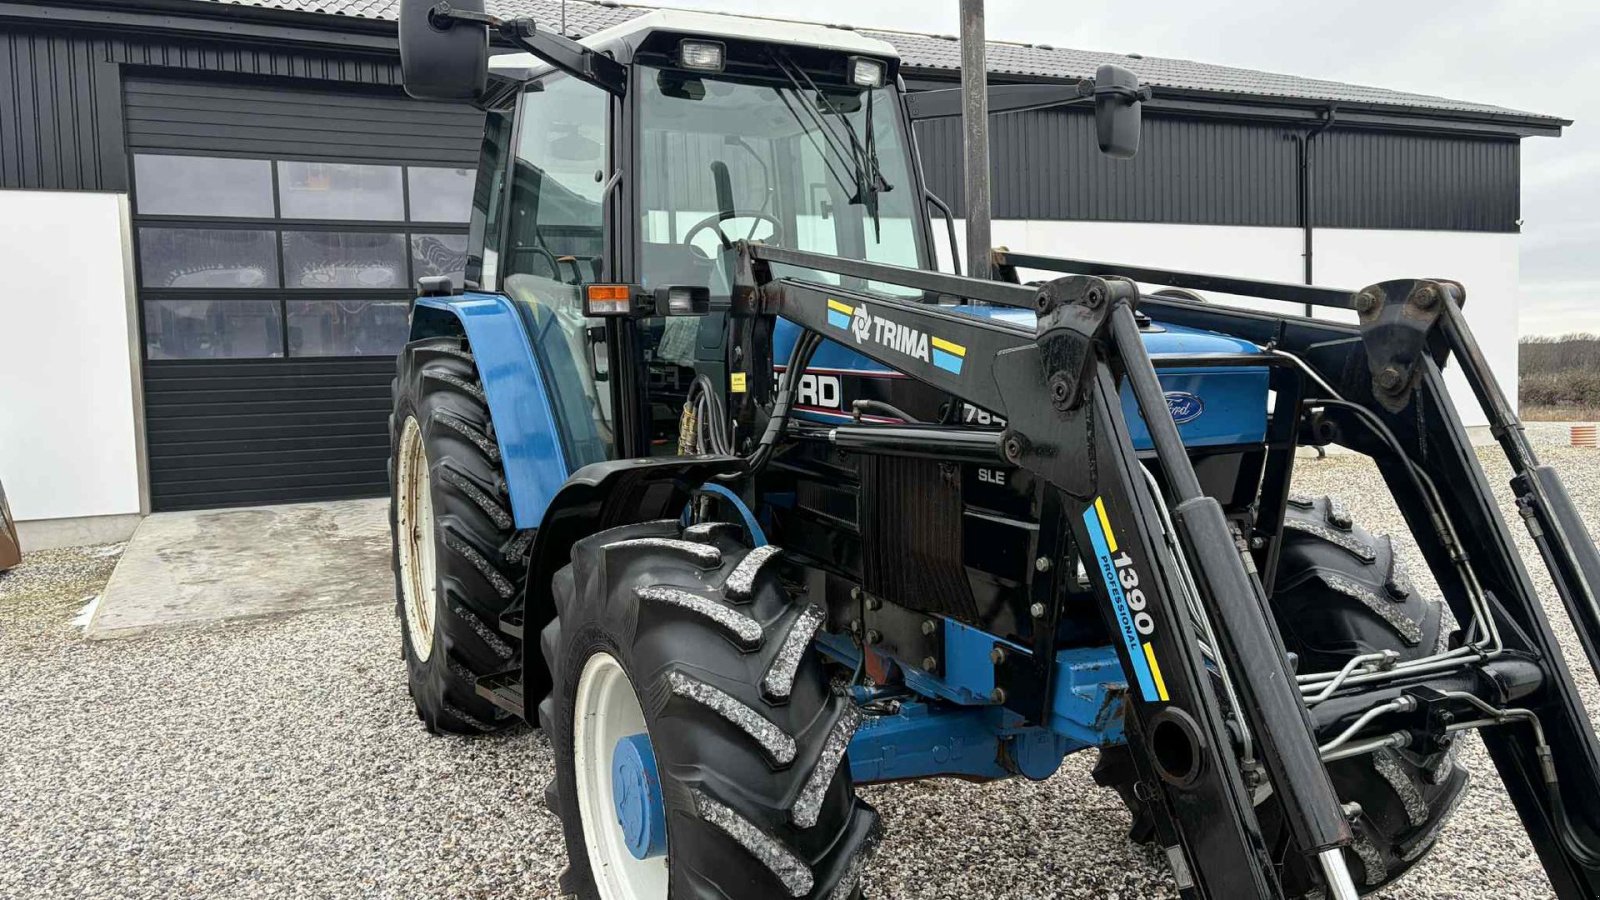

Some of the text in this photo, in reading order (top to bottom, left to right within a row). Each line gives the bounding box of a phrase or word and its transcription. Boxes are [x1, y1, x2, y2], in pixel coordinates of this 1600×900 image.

[873, 315, 930, 363] TRIMA
[773, 371, 840, 408] RD
[978, 468, 1005, 485] SLE
[1101, 555, 1137, 650] PROFESSIONAL
[1114, 551, 1155, 636] 1390
